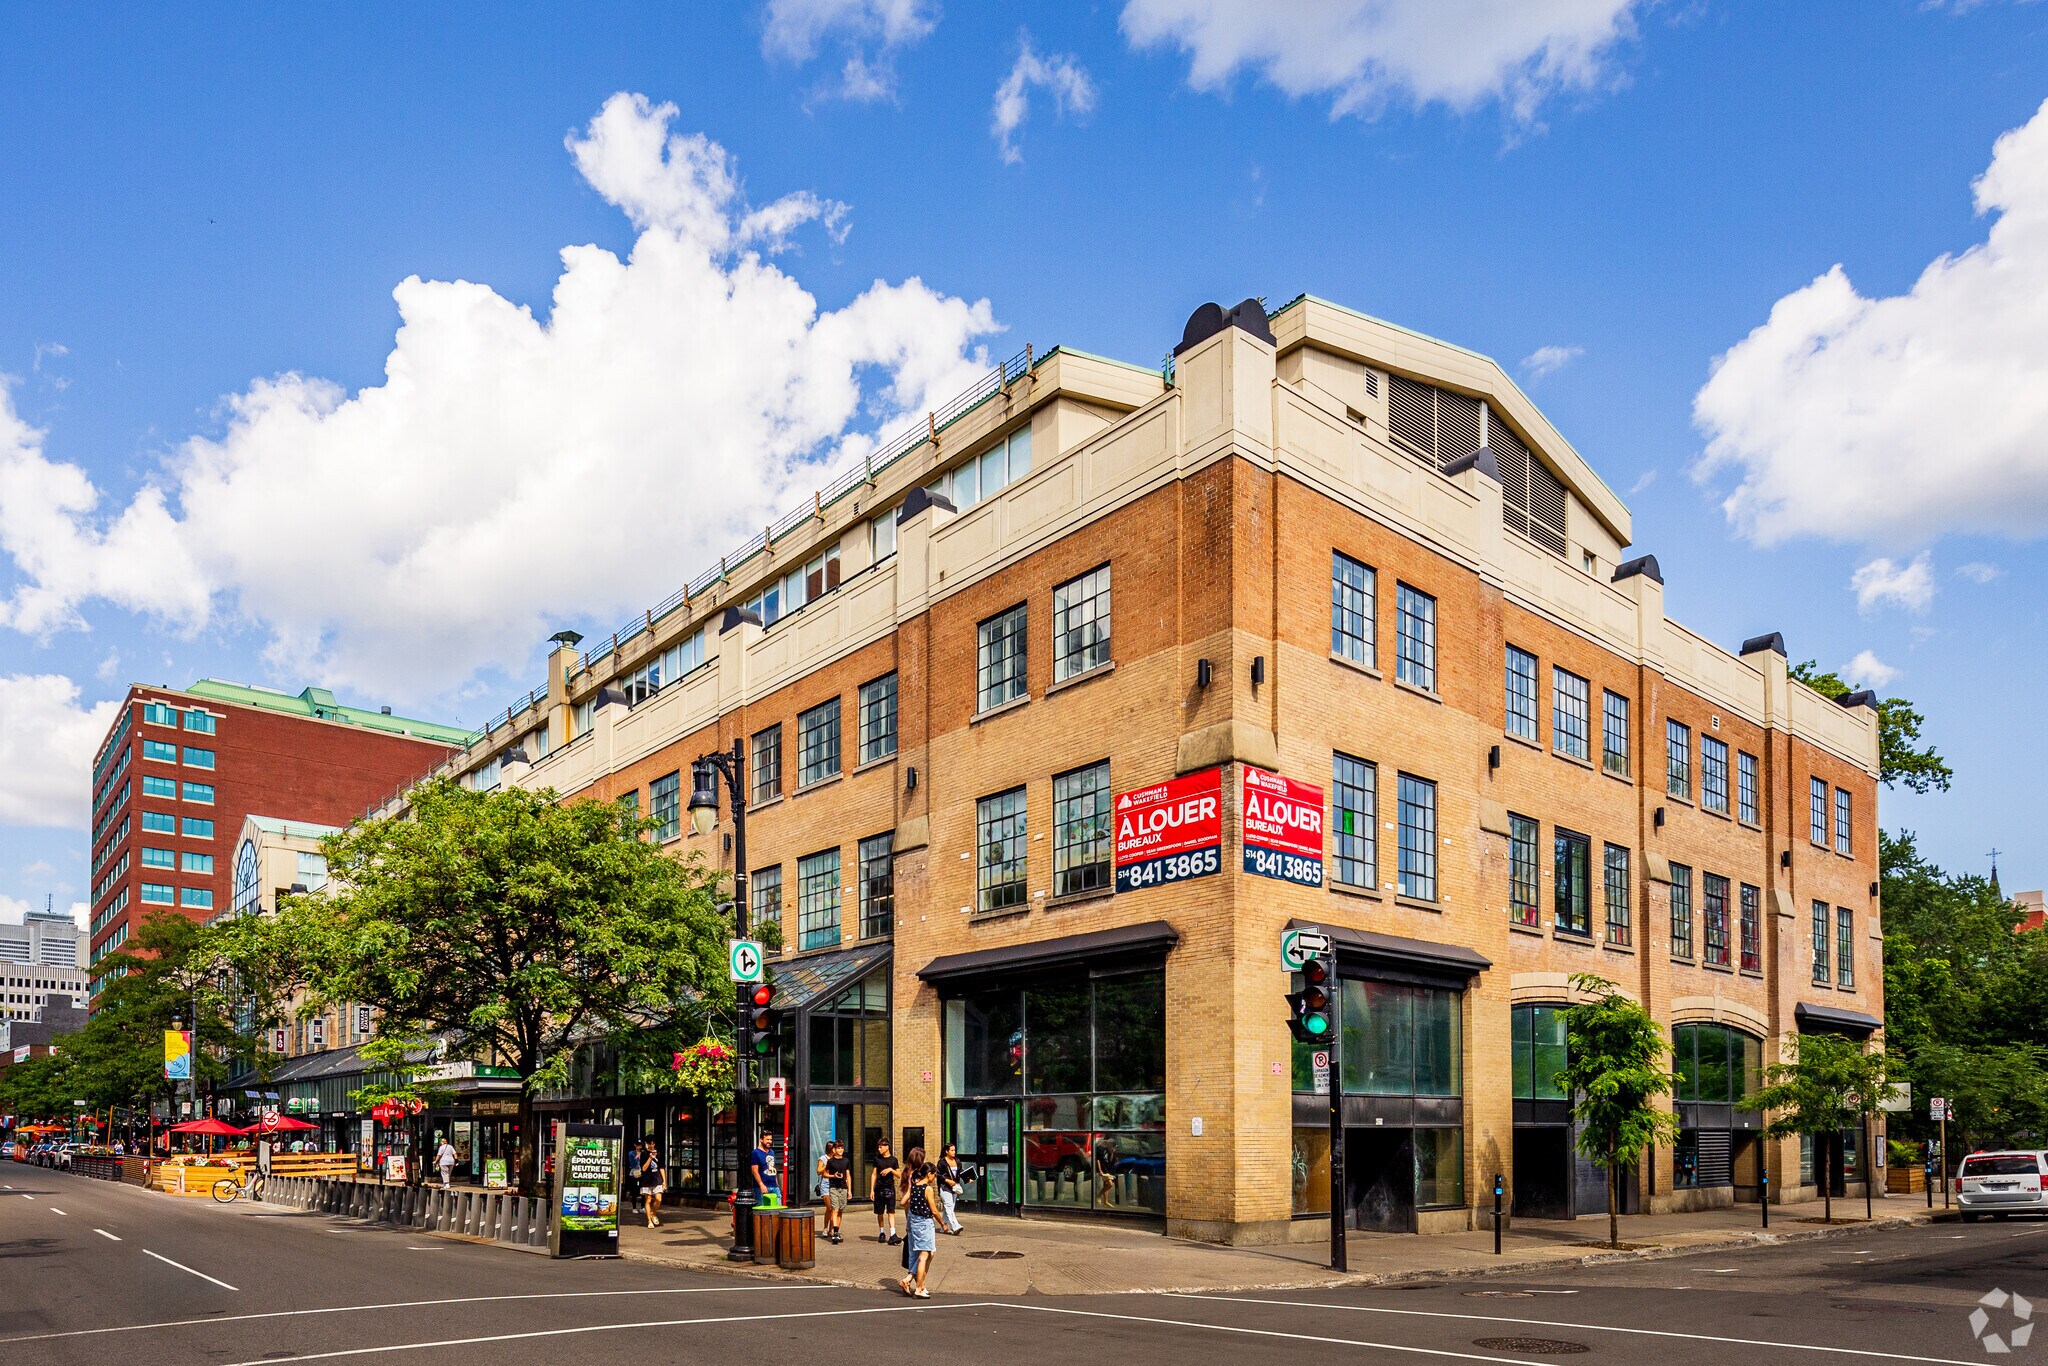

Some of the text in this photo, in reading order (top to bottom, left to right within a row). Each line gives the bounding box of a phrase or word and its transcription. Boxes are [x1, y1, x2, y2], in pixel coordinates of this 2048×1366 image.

[1260, 774, 1283, 785] CUSHMAN
[1260, 781, 1288, 793] WAKEFIELD
[1133, 788, 1162, 800] CUSHMAN
[1133, 792, 1168, 805] WAKEFIELD
[1246, 790, 1321, 834] À LOUER
[1118, 796, 1216, 841] À LOUER
[1246, 819, 1284, 836] BUREAUX
[1117, 833, 1162, 852] BUREAUX
[1118, 849, 1217, 887] 514 841 3865
[1245, 849, 1321, 884] 514 841 3865
[576, 1148, 608, 1157] QUALITÉ
[571, 1156, 612, 1165] ÉPROUVÉE.
[571, 1165, 612, 1173] NEUTRE EN
[572, 1172, 610, 1180] CARBONE.
